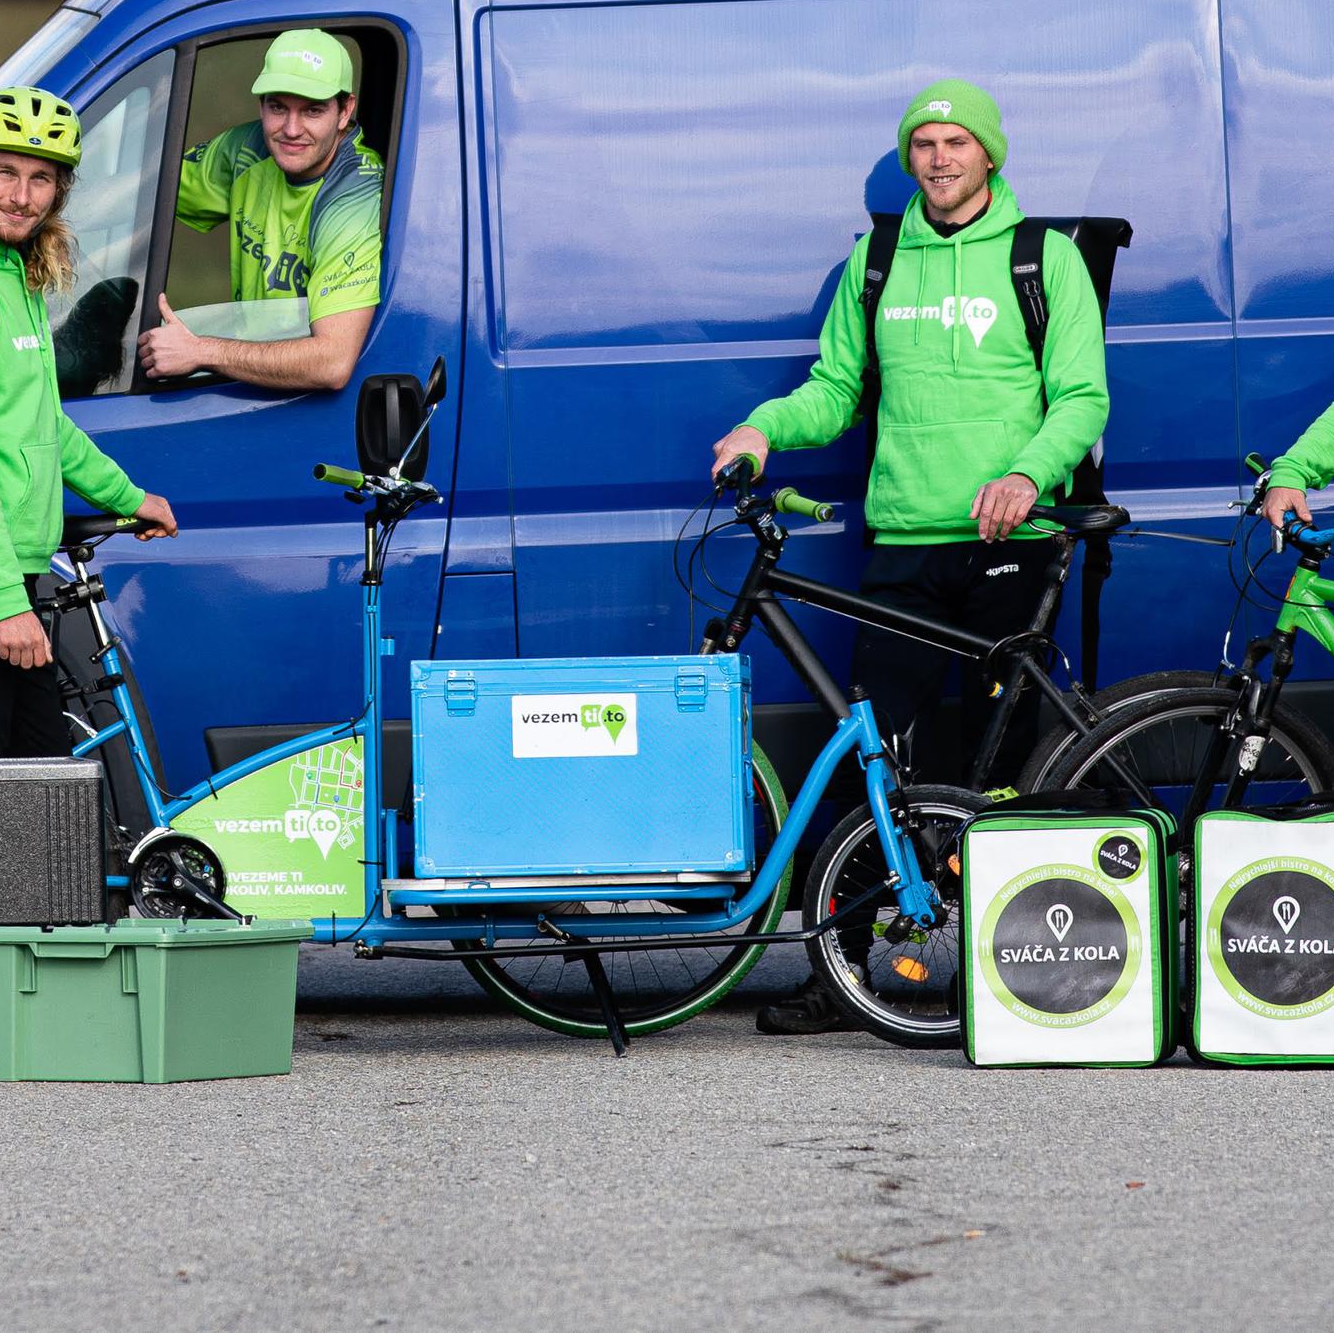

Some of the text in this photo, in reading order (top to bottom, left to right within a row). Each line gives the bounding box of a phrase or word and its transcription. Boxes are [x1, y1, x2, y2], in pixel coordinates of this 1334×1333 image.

[522, 712, 578, 724] vezem
[214, 819, 283, 834] vezem
[290, 871, 303, 882] TI
[274, 883, 348, 895] KAMKOLIV.
[1228, 934, 1281, 955] SVÁČA
[1284, 939, 1295, 954] Z
[1001, 943, 1120, 964] SVÁČA Z KOLA
